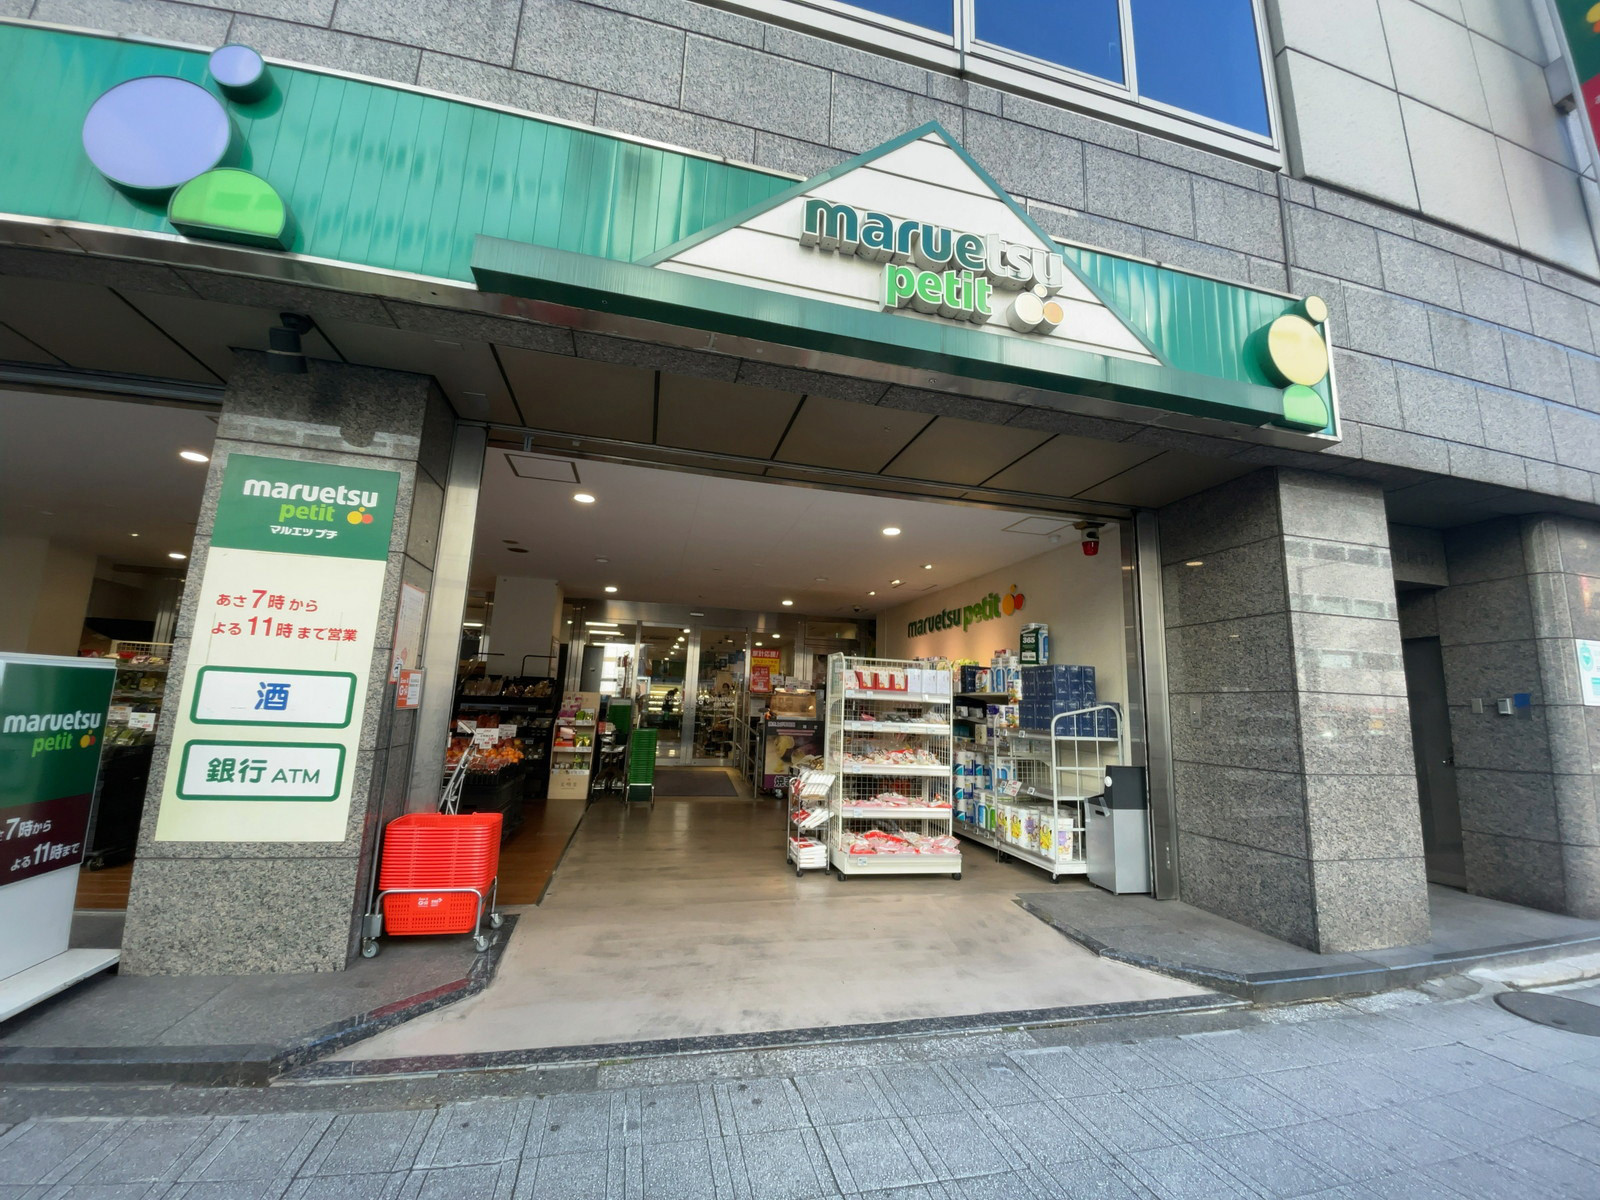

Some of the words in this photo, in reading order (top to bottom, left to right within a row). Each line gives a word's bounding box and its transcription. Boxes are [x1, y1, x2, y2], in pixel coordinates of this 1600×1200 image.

[802, 198, 1064, 289] maruetsu
[884, 262, 993, 316] petit
[242, 478, 379, 508] maruetsu
[278, 503, 336, 523] petit
[907, 607, 962, 639] maruetsu
[962, 592, 1002, 633] petit
[254, 681, 291, 711] 酒
[2, 710, 102, 734] maruetsu
[31, 732, 74, 758] petit
[206, 757, 268, 784] 銀行
[270, 768, 321, 784] ATM
